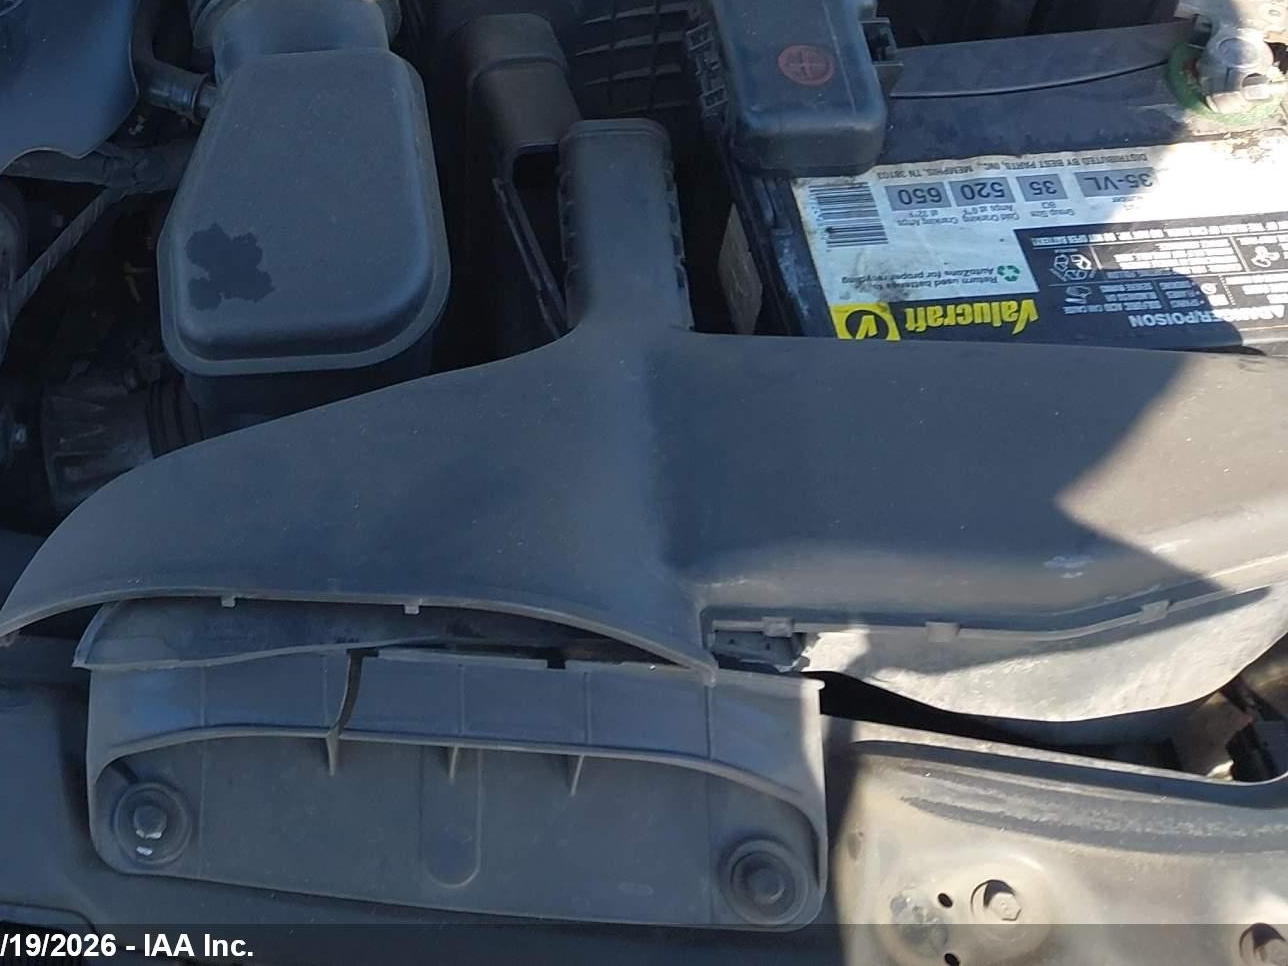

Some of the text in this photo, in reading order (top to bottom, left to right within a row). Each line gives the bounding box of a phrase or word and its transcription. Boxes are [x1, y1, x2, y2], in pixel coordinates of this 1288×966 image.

[1040, 159, 1064, 168] BEST
[1067, 157, 1080, 166] BY
[1083, 153, 1148, 165] DISTRIBUTED
[909, 169, 921, 177] TN
[1085, 173, 1153, 191] 35-VL
[961, 181, 1005, 200] 520
[1029, 180, 1057, 195] 35
[898, 187, 942, 205] 650
[1030, 208, 1075, 218] Group Size
[962, 214, 999, 223] Cranking
[890, 271, 924, 282] proper
[927, 271, 942, 280] for
[944, 268, 994, 278] AutoZone
[934, 278, 959, 286] used
[961, 275, 997, 285] Return
[904, 299, 1039, 335] Valucraft
